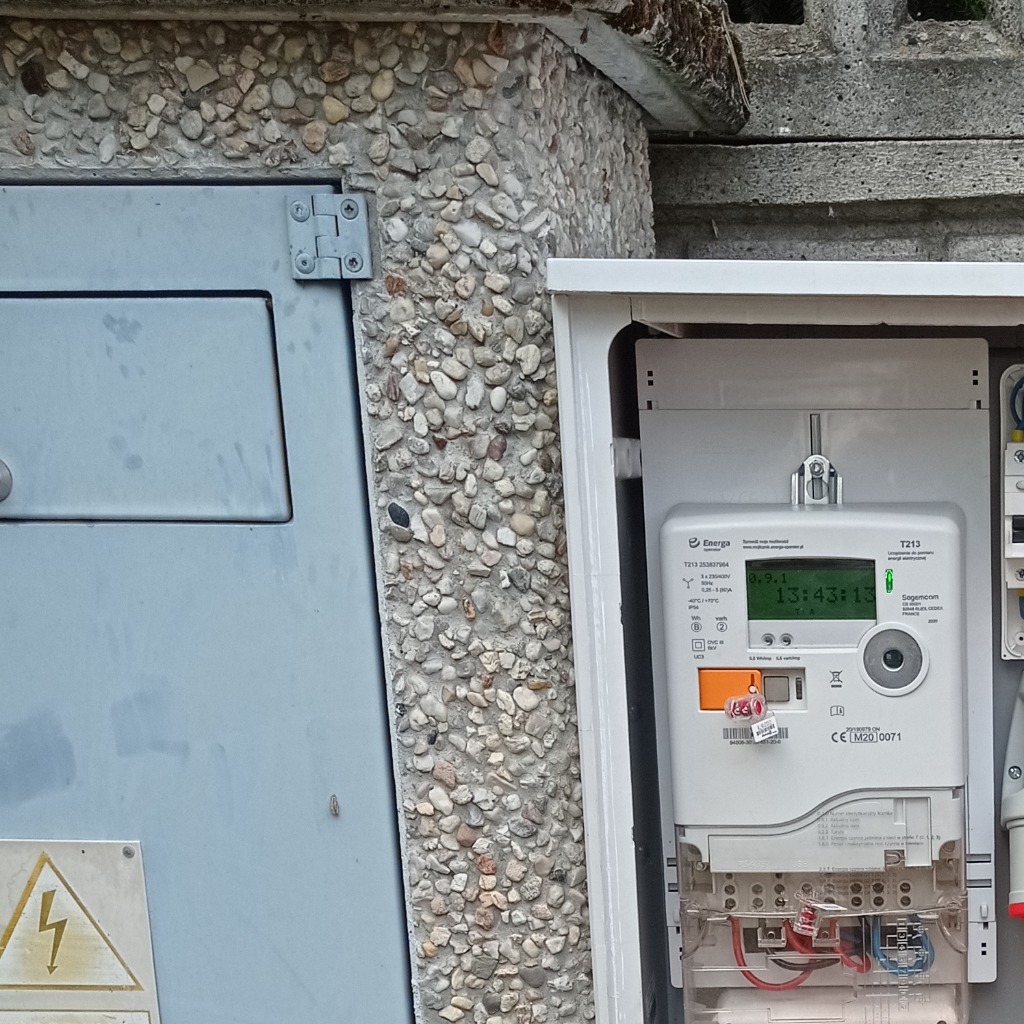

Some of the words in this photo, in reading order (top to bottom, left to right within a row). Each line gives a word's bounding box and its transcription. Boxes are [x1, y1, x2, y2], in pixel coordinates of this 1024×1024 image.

[703, 539, 730, 548] Energa
[900, 540, 921, 548] T213
[749, 573, 786, 583] 0.9.1
[776, 587, 875, 603] 13:43:13
[854, 733, 874, 742] M20
[879, 732, 901, 741] 0071
